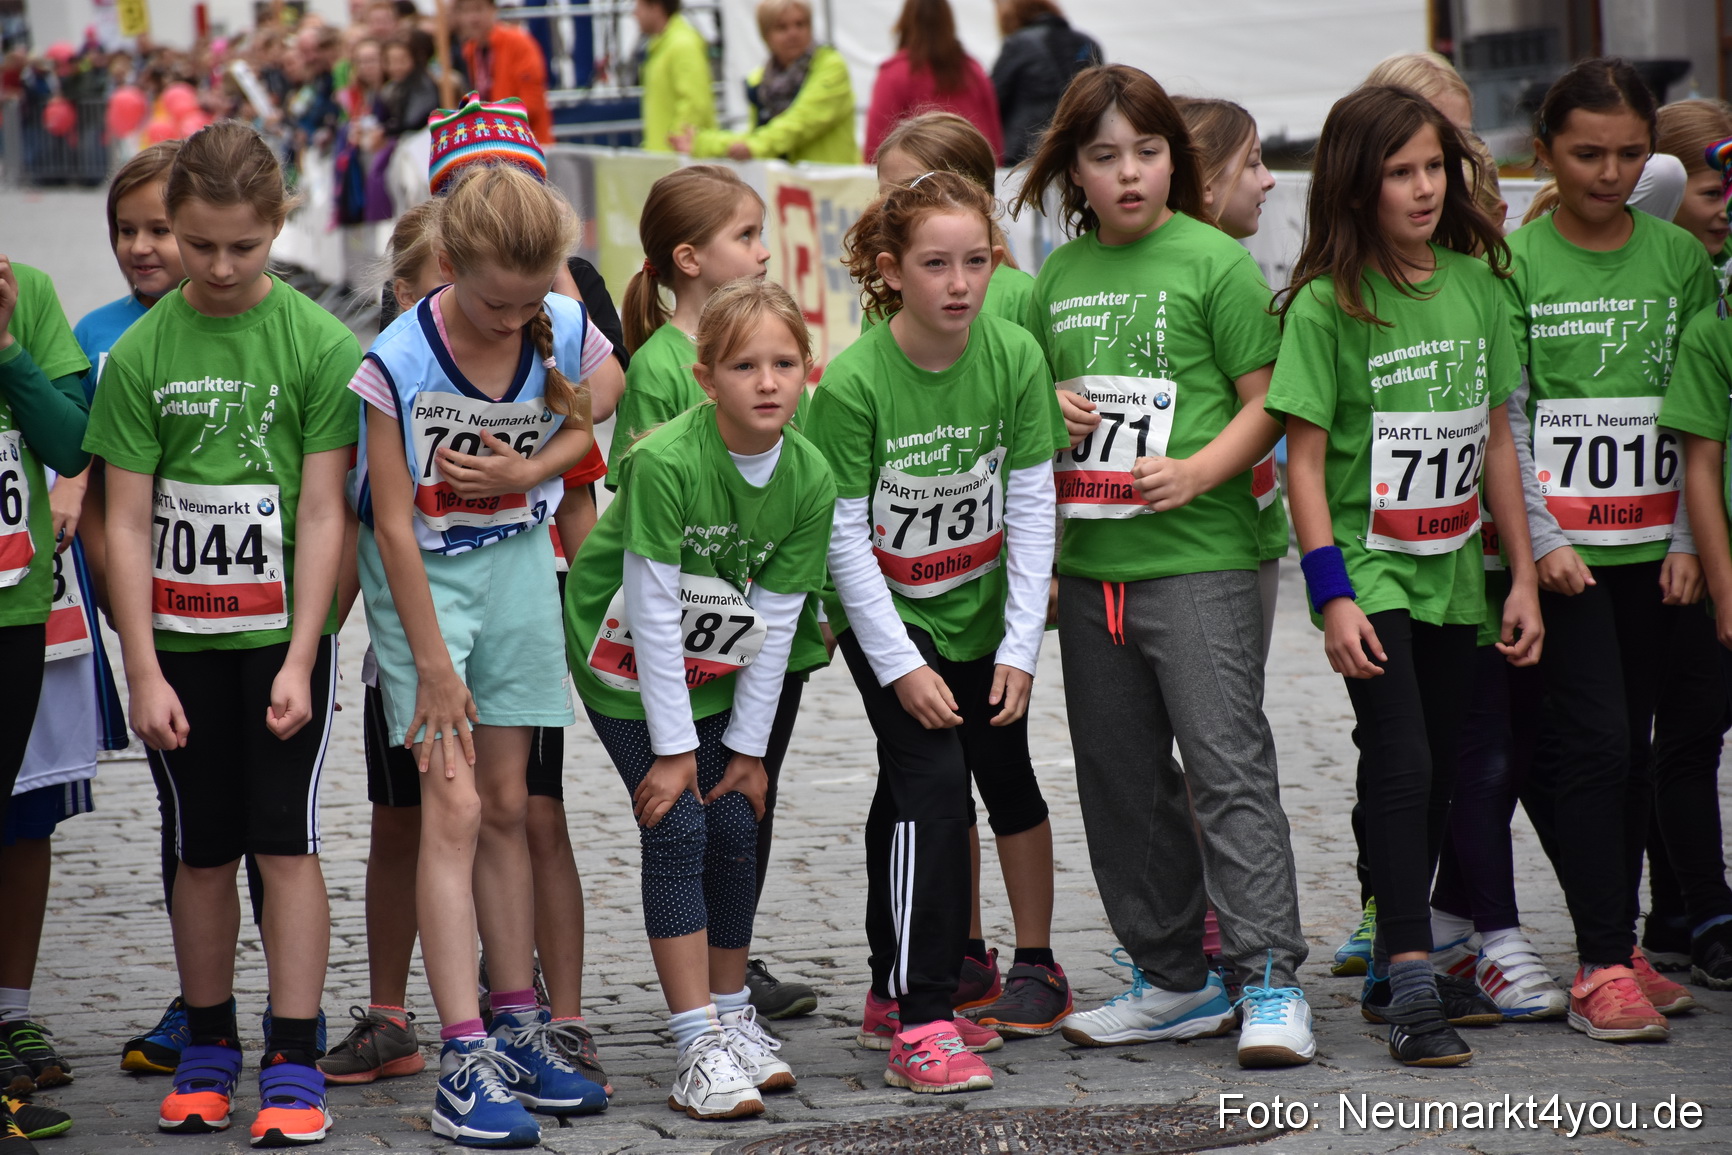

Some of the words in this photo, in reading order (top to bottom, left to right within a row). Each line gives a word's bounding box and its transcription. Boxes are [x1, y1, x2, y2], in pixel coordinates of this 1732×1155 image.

[1050, 292, 1130, 317] Neumarkter
[1531, 297, 1636, 318] Neumarkter
[1052, 312, 1111, 338] Sadtlauf
[1155, 291, 1168, 379] BAMBINI
[1531, 318, 1615, 339] Stadtlauf
[1661, 297, 1678, 387] BAMBINI
[1474, 338, 1486, 404] BAMBI
[1083, 390, 1147, 405] Neumarkt
[415, 406, 464, 423] PARTL
[468, 413, 537, 427] Neumarkt
[1540, 414, 1592, 427] PARTL
[1597, 413, 1658, 427] Neumark
[886, 425, 972, 453] Numarkter
[1056, 412, 1151, 463] 071
[1378, 427, 1432, 440] PARTL
[1391, 434, 1487, 502] 7122
[1553, 433, 1679, 490] 7016
[880, 480, 930, 500] PARTL
[933, 470, 990, 498] Neumarkt
[1058, 477, 1133, 499] Katharina
[179, 498, 251, 515] Neumarkt
[889, 484, 994, 550] 7131
[1587, 504, 1644, 525] Alicia
[1417, 510, 1470, 536] Leonie
[154, 515, 268, 576] 7044
[910, 552, 972, 581] Sophia
[164, 588, 239, 613] Tamina
[680, 589, 743, 606] Neumarkt
[467, 1039, 485, 1051] NIKE
